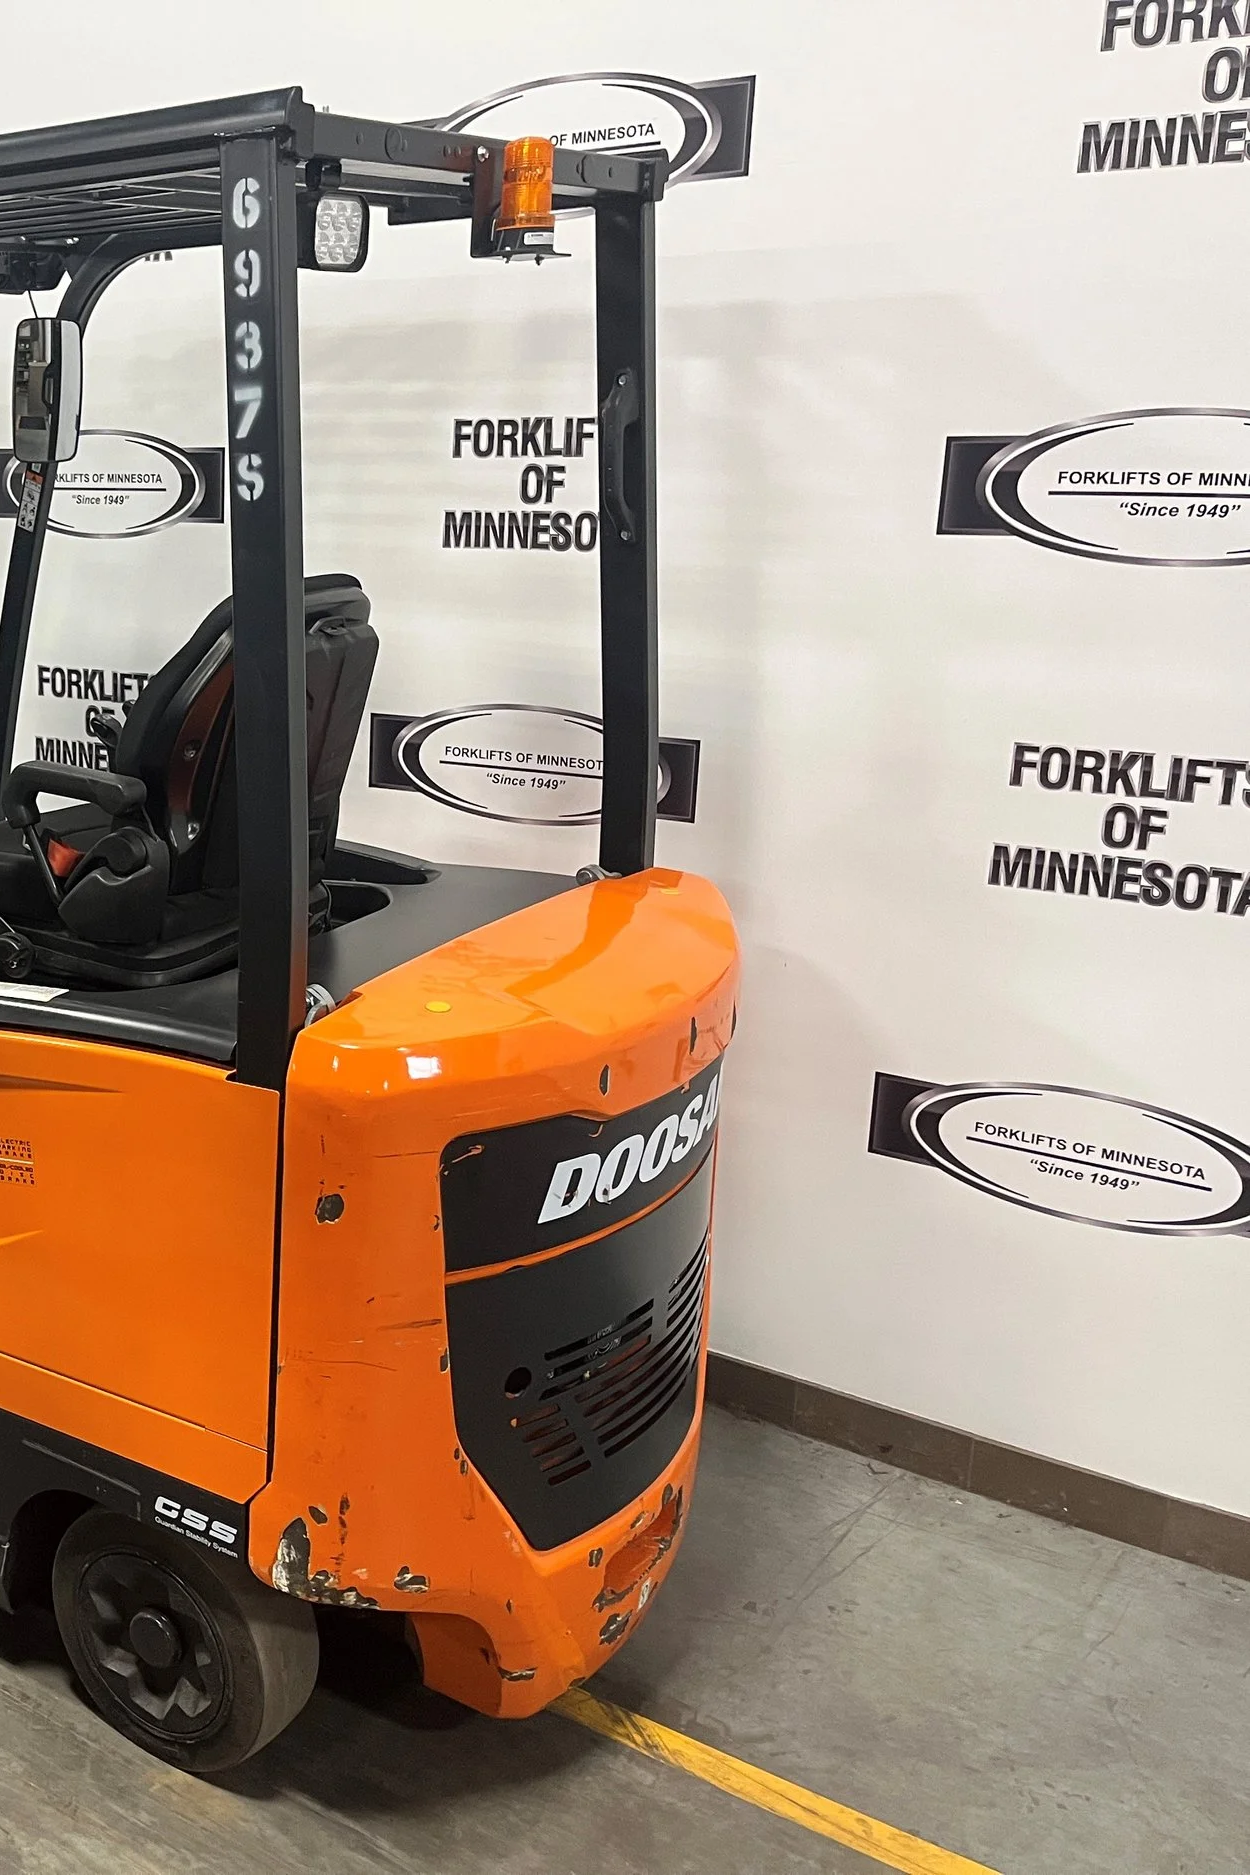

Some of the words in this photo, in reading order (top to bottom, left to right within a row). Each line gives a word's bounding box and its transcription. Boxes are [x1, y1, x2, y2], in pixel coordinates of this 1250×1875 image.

[1100, 0, 1250, 52] FORK
[1202, 45, 1250, 104] O
[550, 134, 567, 146] OF
[571, 123, 655, 145] MINNESOTA
[1077, 109, 1250, 173] MINNE
[452, 416, 598, 458] FORKLIF
[92, 473, 105, 483] OF
[107, 474, 162, 484] MINNESOTA
[519, 463, 567, 505] OF
[1057, 471, 1161, 486] FORKLIFTS
[1166, 472, 1193, 486] OF
[1198, 473, 1250, 487] MINN
[442, 510, 599, 552] MINNESO
[37, 665, 152, 703] FORKLIFT
[34, 735, 109, 772] MINNE
[445, 746, 512, 762] FORKLIFTS
[516, 752, 533, 764] OF
[536, 754, 604, 771] MINNESOT
[1009, 742, 1250, 808] FORKLIFT
[1101, 802, 1169, 851] OF
[974, 1121, 1067, 1150] FORKLIFTS
[1072, 1142, 1096, 1156] OF
[1101, 1148, 1206, 1180] MINNESOTA
[155, 1516, 185, 1535] Guardian
[185, 1530, 212, 1548] Stability
[212, 1542, 239, 1559] System
